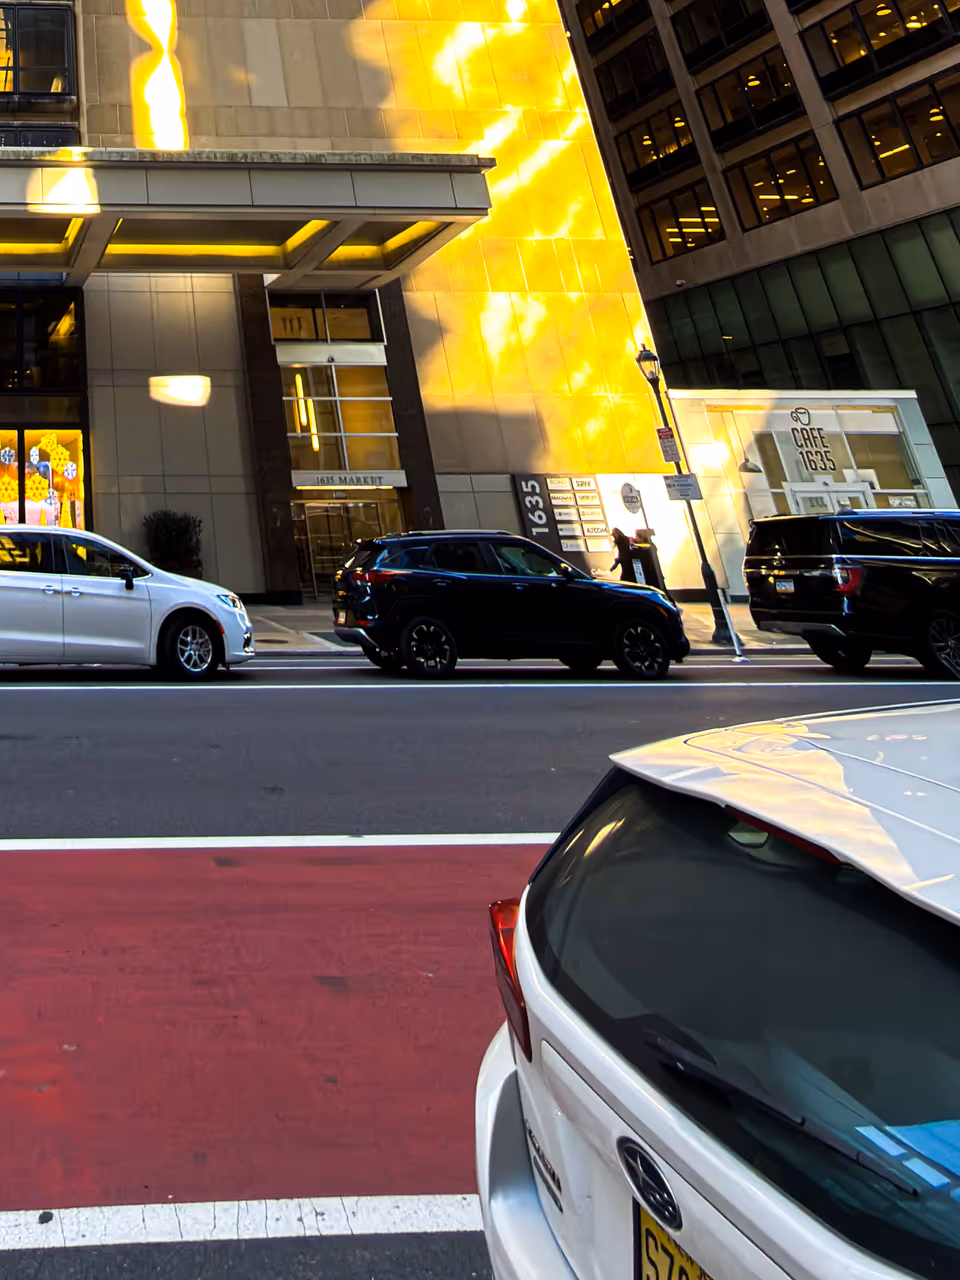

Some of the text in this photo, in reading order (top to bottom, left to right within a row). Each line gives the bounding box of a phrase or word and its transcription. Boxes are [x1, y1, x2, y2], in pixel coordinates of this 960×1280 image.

[791, 427, 829, 449] CAFE
[798, 450, 837, 472] 1635
[338, 475, 384, 486] MARKET
[521, 480, 550, 536] 1635
